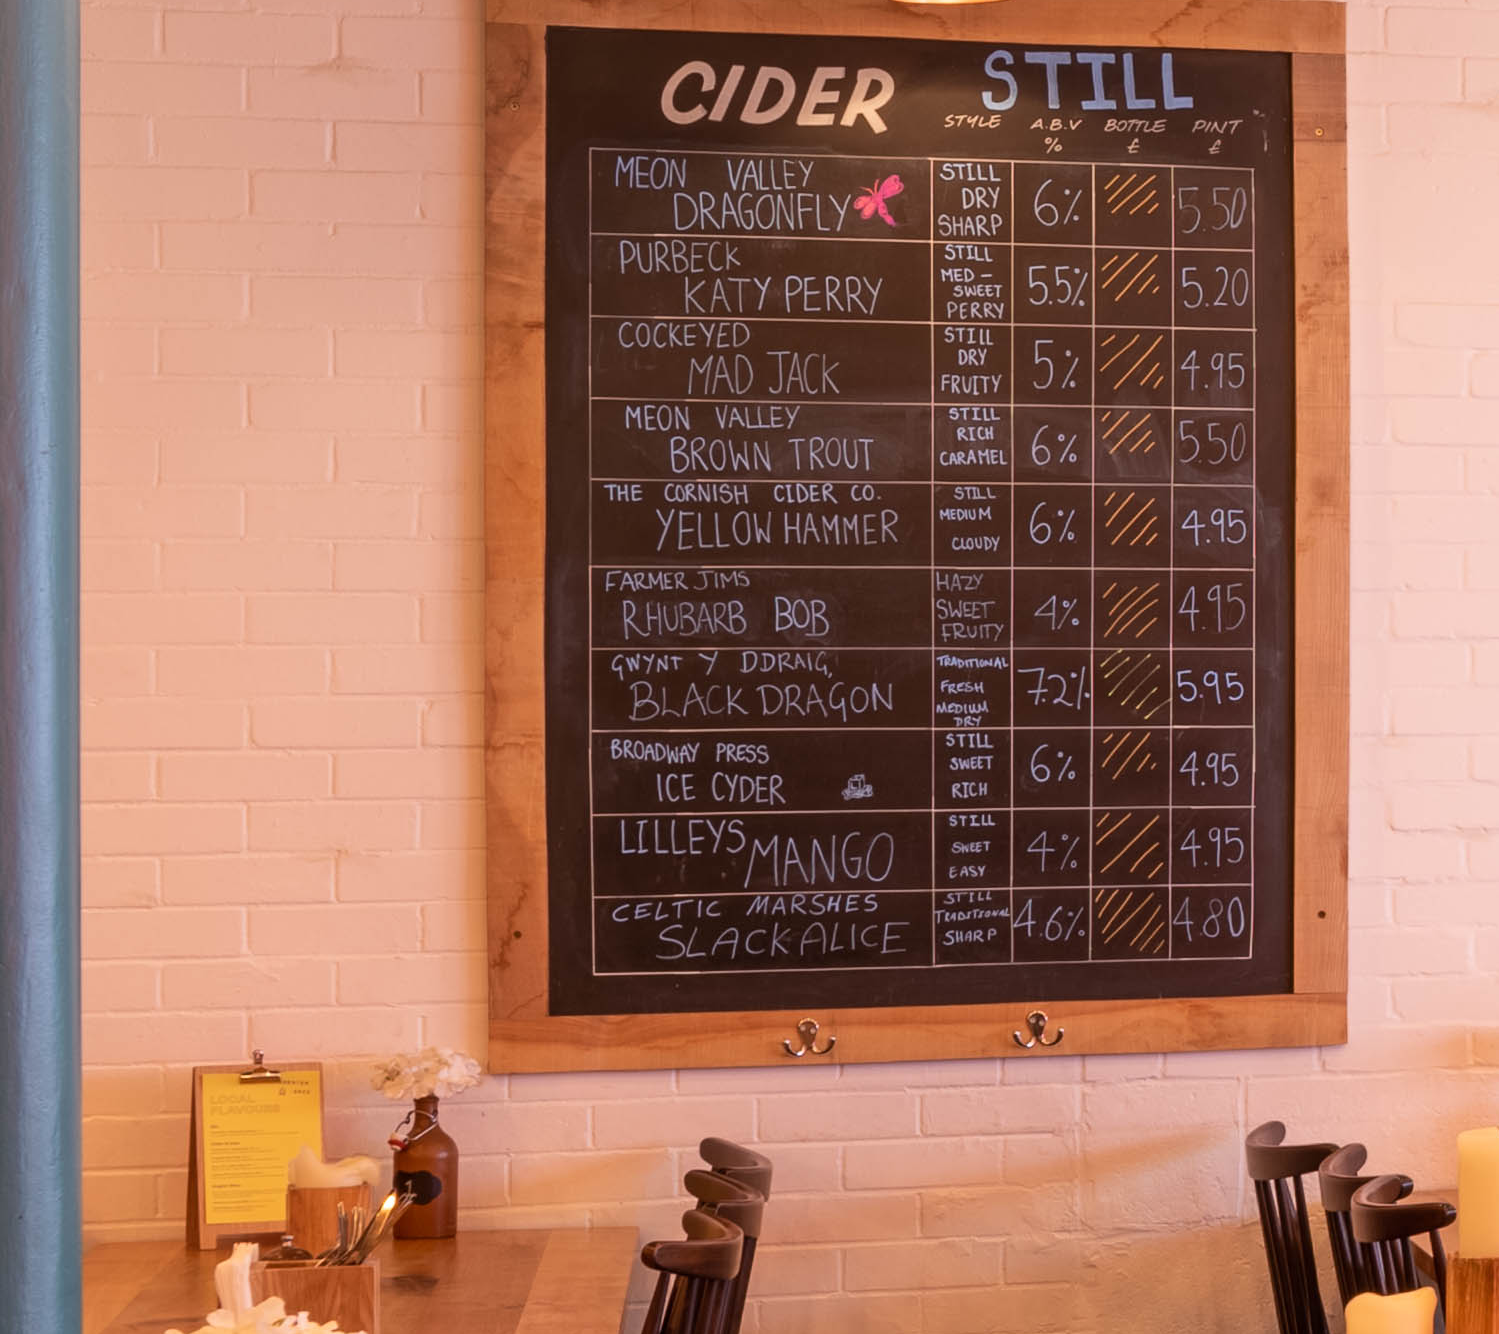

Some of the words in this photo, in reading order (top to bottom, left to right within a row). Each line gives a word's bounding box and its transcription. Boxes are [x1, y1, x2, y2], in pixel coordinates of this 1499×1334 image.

[982, 50, 1194, 110] STILL
[661, 60, 895, 134] CIDER
[944, 115, 1002, 128] STYLE
[1104, 119, 1168, 132] BOTTLE
[1192, 120, 1243, 134] PINT
[615, 156, 687, 189] MEON
[727, 160, 814, 191] VALLEY
[939, 164, 1001, 181] STILL
[961, 187, 1000, 209] DRY
[673, 193, 851, 232] DRAGONFLY
[1178, 187, 1247, 234] 5.50
[938, 215, 1002, 237] SHARP
[619, 240, 741, 274] PURBECK
[944, 244, 992, 261] STILL
[685, 276, 771, 314] KATY
[785, 275, 883, 315] PERRY
[1181, 267, 1248, 308] 5.20
[948, 303, 1004, 319] PERRY
[618, 322, 750, 348] COCKEYED
[944, 327, 993, 345] STILL
[958, 349, 987, 366] DRY
[688, 354, 753, 394] MAD
[766, 352, 840, 394] JACK
[1181, 350, 1245, 391] 4.95
[941, 374, 1001, 395] FRUITY
[625, 405, 690, 431] MEON
[716, 405, 800, 428] VALLEY
[949, 408, 1000, 421] STILL
[957, 427, 993, 441] RICH
[670, 437, 771, 473] BROWN
[788, 438, 874, 470] TROUT
[940, 450, 1007, 466] CARAMEL
[604, 484, 642, 502] THE
[664, 483, 748, 505] CORNISH
[773, 483, 838, 504] CIDER
[953, 487, 996, 499] STILL
[939, 507, 992, 520] MEDIUM
[656, 508, 771, 551] YELLOW
[784, 509, 898, 545] HAMMER
[1181, 508, 1247, 546] 4.95
[952, 537, 1000, 551] CLOUDY
[605, 571, 688, 592] FARMER
[693, 570, 750, 590] JIMS
[936, 573, 984, 591] HAZY
[622, 600, 748, 639] RHUBARB
[774, 596, 829, 636] BOB
[936, 599, 995, 619] SWEET
[1179, 583, 1246, 632] 4.95
[941, 622, 1004, 642] FRUITY
[611, 654, 682, 680] GWYNT
[698, 651, 718, 675] Y
[940, 681, 984, 693] FRESH
[1177, 670, 1245, 704] 5.95
[629, 680, 749, 721] BLACK
[757, 682, 893, 722] DRAGON
[611, 739, 700, 764] BROADWAY
[716, 744, 769, 764] PRESS
[946, 733, 993, 748] STILL
[950, 757, 993, 770] SWEET
[1180, 751, 1239, 786] 4.95
[657, 774, 696, 801] ICE
[711, 772, 786, 804] CYDER
[952, 783, 988, 798] RICH
[949, 815, 995, 826] STILL
[621, 819, 746, 854] LILLEYS
[1181, 828, 1244, 867] 4.95
[952, 842, 991, 854] SWEET
[744, 832, 894, 888] MANGO
[949, 865, 986, 878] EASY
[612, 900, 722, 922] CELTIC
[746, 894, 879, 915] MARSHES
[944, 892, 992, 904] STILL
[944, 929, 997, 946] SHARP
